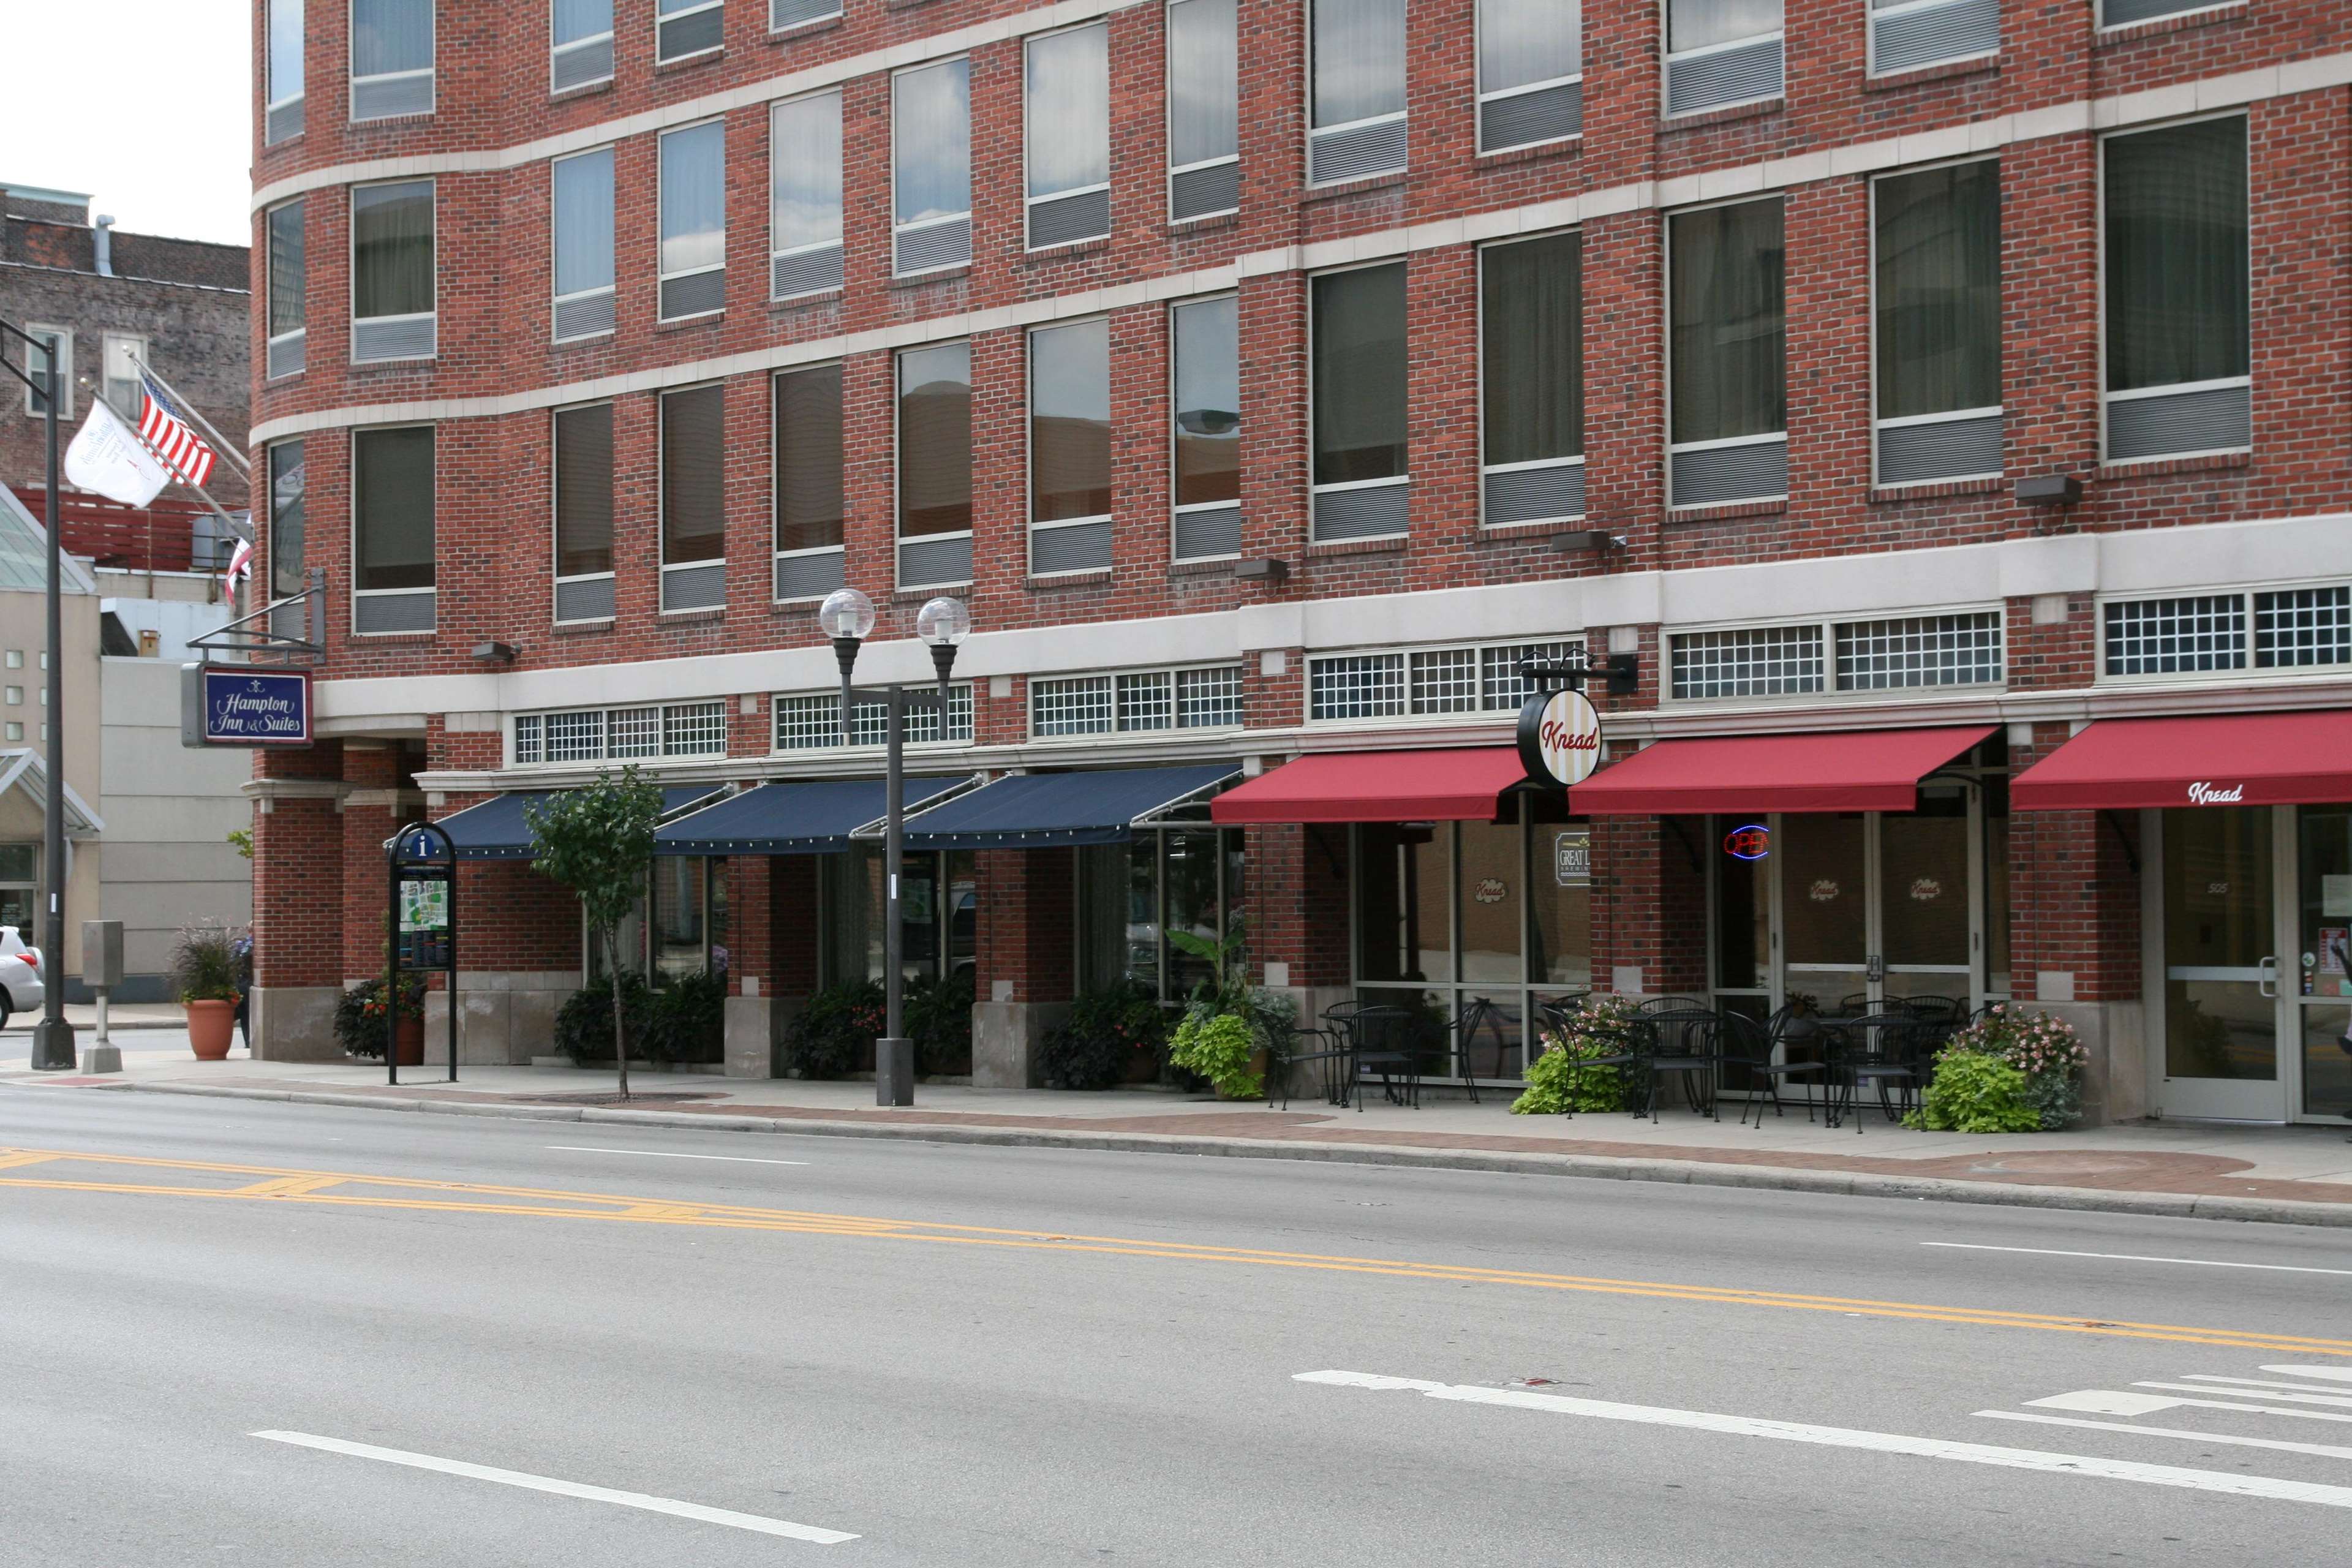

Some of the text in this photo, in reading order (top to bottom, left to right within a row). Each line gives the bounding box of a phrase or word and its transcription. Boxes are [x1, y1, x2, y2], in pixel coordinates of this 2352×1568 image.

[217, 693, 295, 715] Hampton
[210, 715, 300, 733] Inn & Suites
[1542, 721, 1597, 753] Knead
[2188, 782, 2243, 805] Knead
[1559, 850, 1583, 865] GREAT
[1475, 883, 1504, 897] Knead
